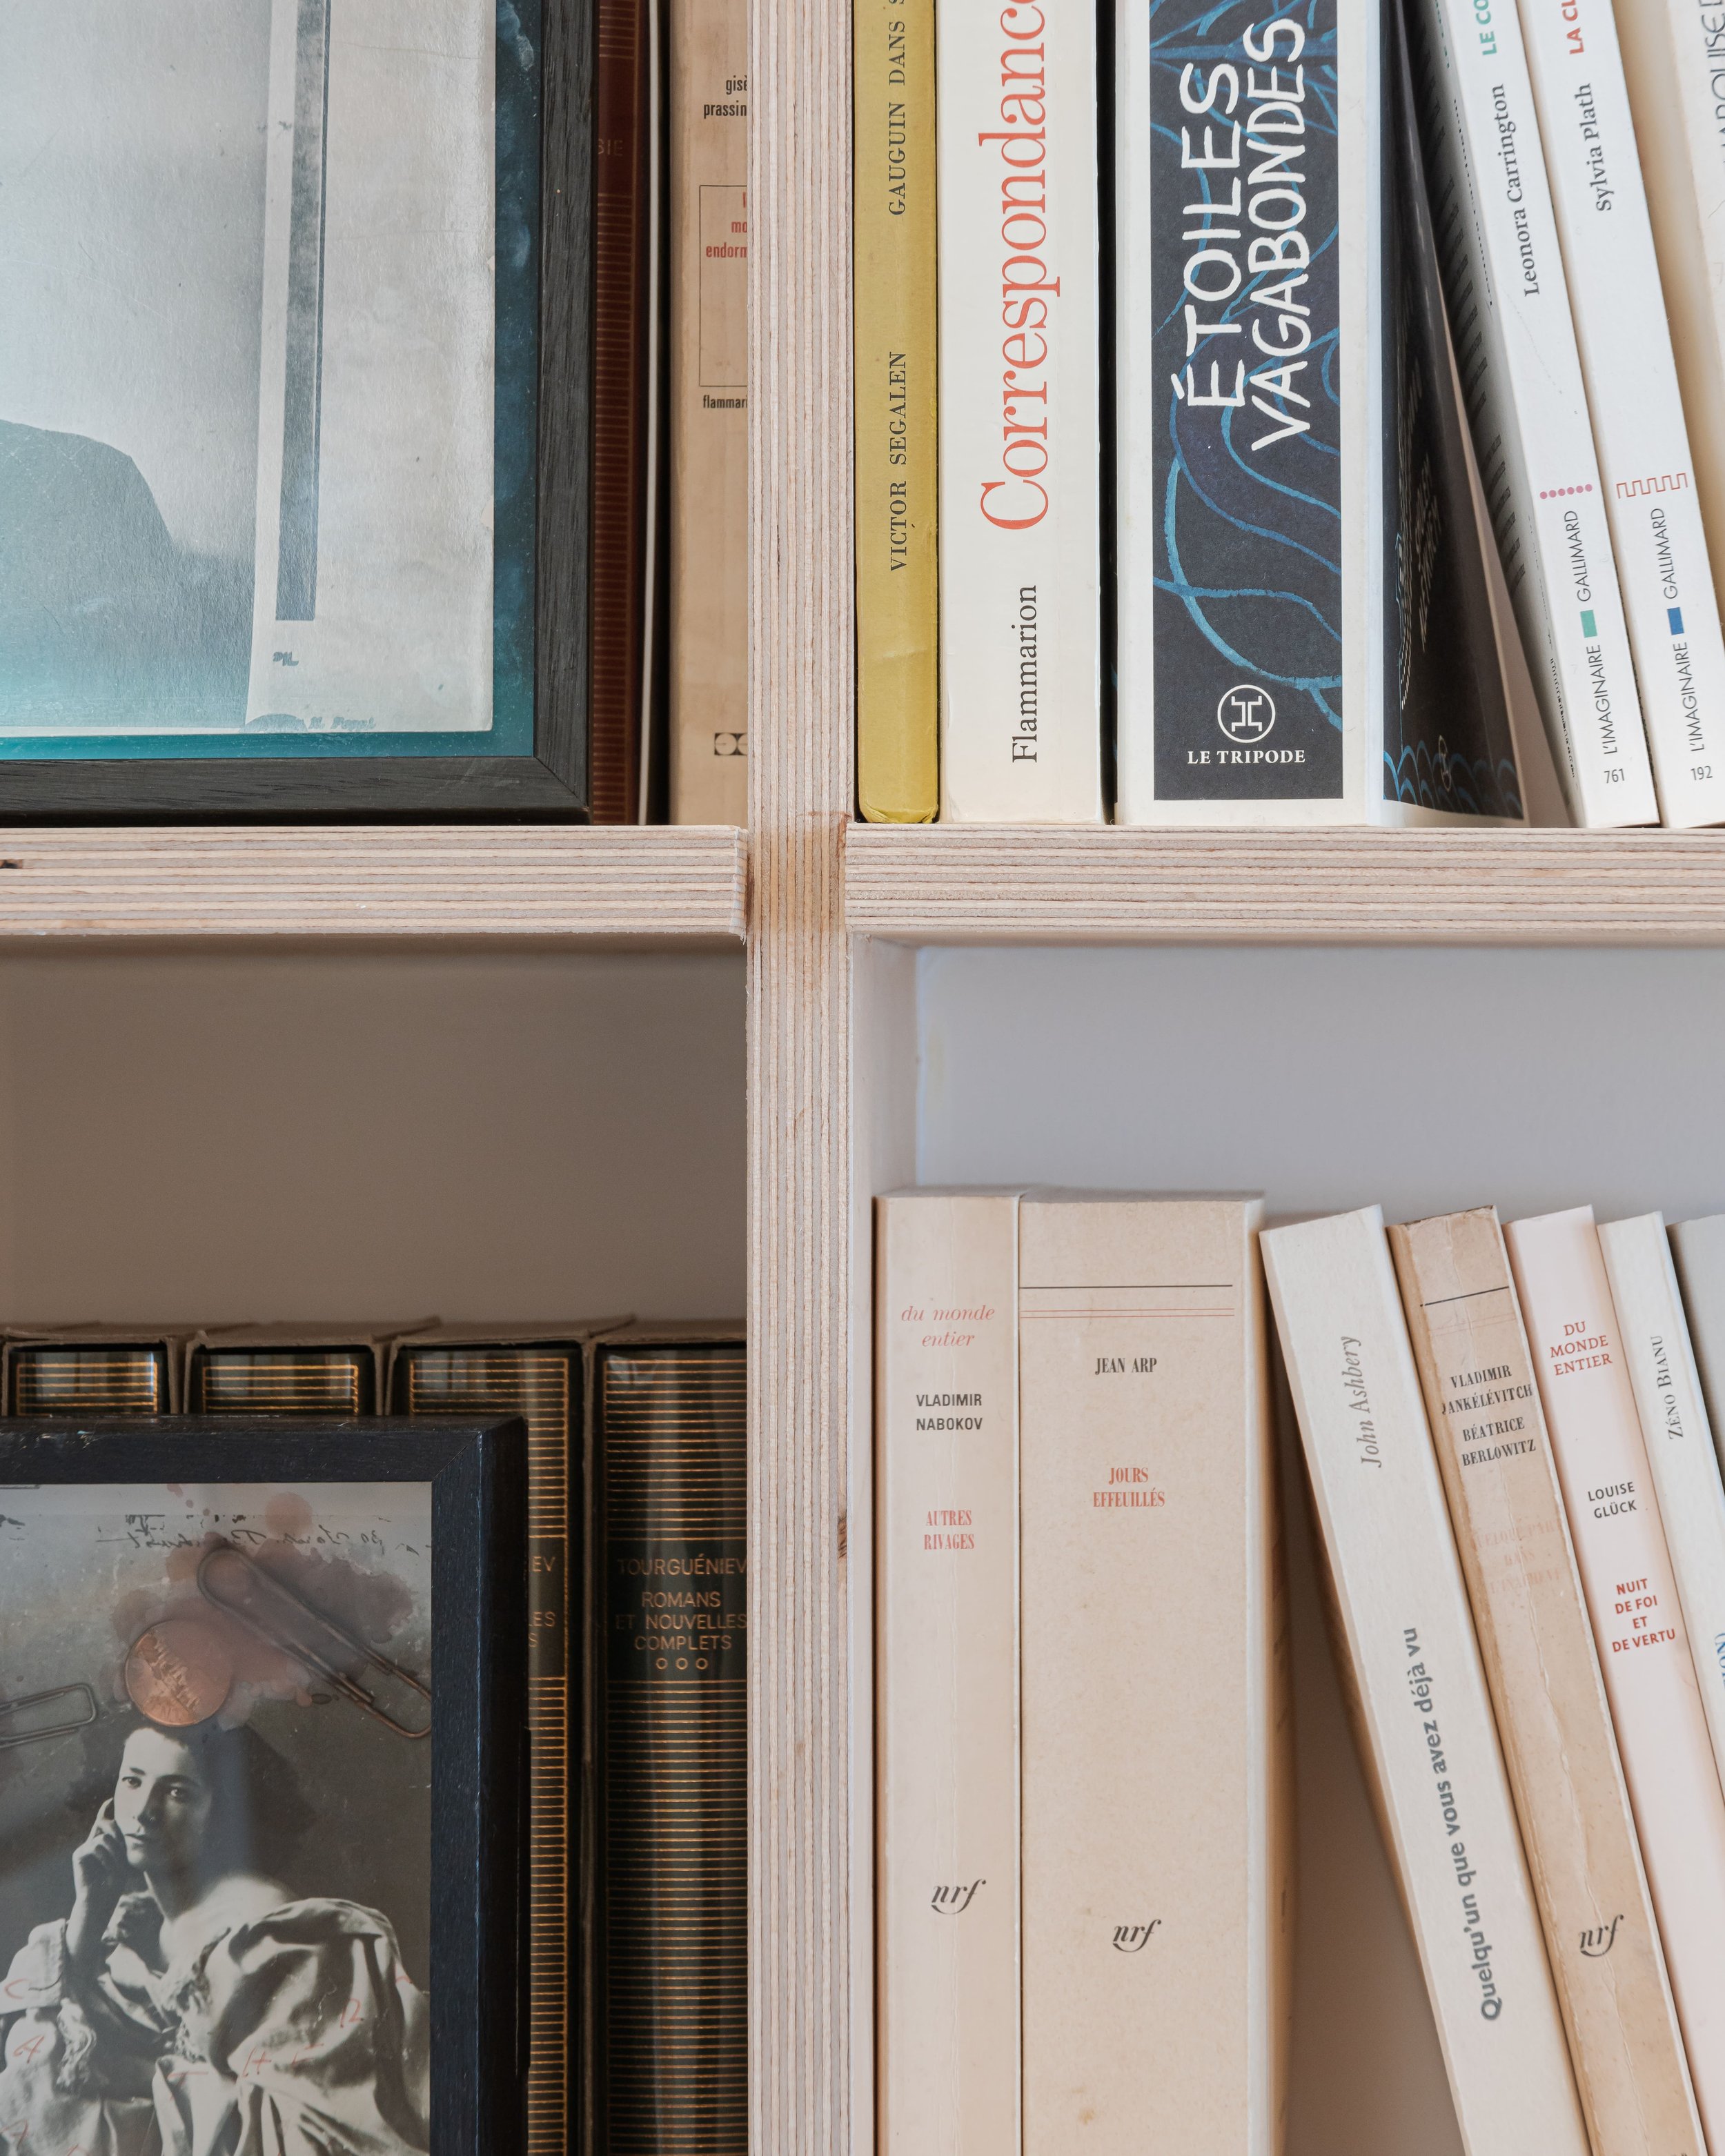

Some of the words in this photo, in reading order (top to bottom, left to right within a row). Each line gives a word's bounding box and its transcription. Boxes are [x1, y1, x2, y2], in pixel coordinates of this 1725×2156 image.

[888, 20, 906, 86] DANS
[1479, 31, 1497, 56] LE
[1566, 27, 1585, 55] LA
[703, 100, 747, 119] prassin
[1574, 82, 1599, 142] Plath
[1492, 83, 1524, 203] Carrington
[888, 101, 907, 216] GAUGUIN
[1586, 146, 1614, 212] Sylvia
[1172, 62, 1245, 408] ÉTOILES
[1243, 18, 1311, 451] VAGABONDES
[978, 0, 1061, 531] Correspondanc
[1509, 207, 1539, 297] Leonora
[889, 351, 907, 466] SEGALEN
[890, 481, 907, 572] VICTOR
[1564, 510, 1592, 602] GALLIMARD
[1650, 507, 1679, 600] GALLIMARD
[1011, 584, 1038, 763] Flammarion
[1586, 644, 1618, 755] L'IMAGINAIRE
[1673, 641, 1705, 752] L'IMAGINAIRE
[1187, 751, 1211, 764] LE
[1216, 749, 1306, 764] TRIPODE
[1604, 768, 1626, 784] 761
[1690, 765, 1714, 782] 192
[901, 1305, 925, 1321] du
[932, 1305, 995, 1321] monde
[922, 1332, 975, 1347] entier
[1564, 1321, 1586, 1336] DU
[1550, 1334, 1609, 1358] MONDE
[1094, 1358, 1126, 1376] JEAN
[1131, 1357, 1158, 1374] ARP
[1340, 1336, 1371, 1414] Ashbery
[1554, 1353, 1613, 1376] ENTIER
[1650, 1335, 1673, 1389] BIANU
[1450, 1365, 1513, 1389] VLADIMIR
[916, 1394, 983, 1407] VLADIMIR
[916, 1417, 983, 1431] NABOKOV
[1462, 1416, 1526, 1442] BÉATRICE
[1664, 1394, 1684, 1440] ZÉNO
[1356, 1419, 1382, 1469] John
[1461, 1439, 1537, 1467] BERLOWITZ
[1108, 1467, 1149, 1485] JOURS
[1093, 1487, 1165, 1508] EFFEUILLÉS
[1587, 1481, 1635, 1502] LOUISE
[925, 1510, 972, 1527] AUTRES
[1593, 1499, 1637, 1520] GLÜCK
[923, 1534, 976, 1550] RIVAGES
[641, 1590, 722, 1608] ROMANS
[1616, 1578, 1648, 1596] NUIT
[1615, 1600, 1633, 1615] DE
[1635, 1594, 1658, 1611] FOI
[645, 1612, 747, 1630] NOUVELLES
[1632, 1616, 1648, 1630] ET
[634, 1635, 733, 1651] COMPLETS
[1403, 1628, 1421, 1657] vu
[1612, 1638, 1630, 1653] DE
[1632, 1628, 1677, 1649] VERTU
[1407, 1661, 1434, 1713] déjà
[1423, 1720, 1448, 1774] avez
[1437, 1780, 1461, 1837] vous
[1451, 1841, 1477, 1887] que
[931, 1879, 987, 1915] nrf
[1112, 1919, 1162, 1953] nrf
[1578, 1914, 1625, 1957] nrf
[1461, 1893, 1503, 2021] Quelqu'un
